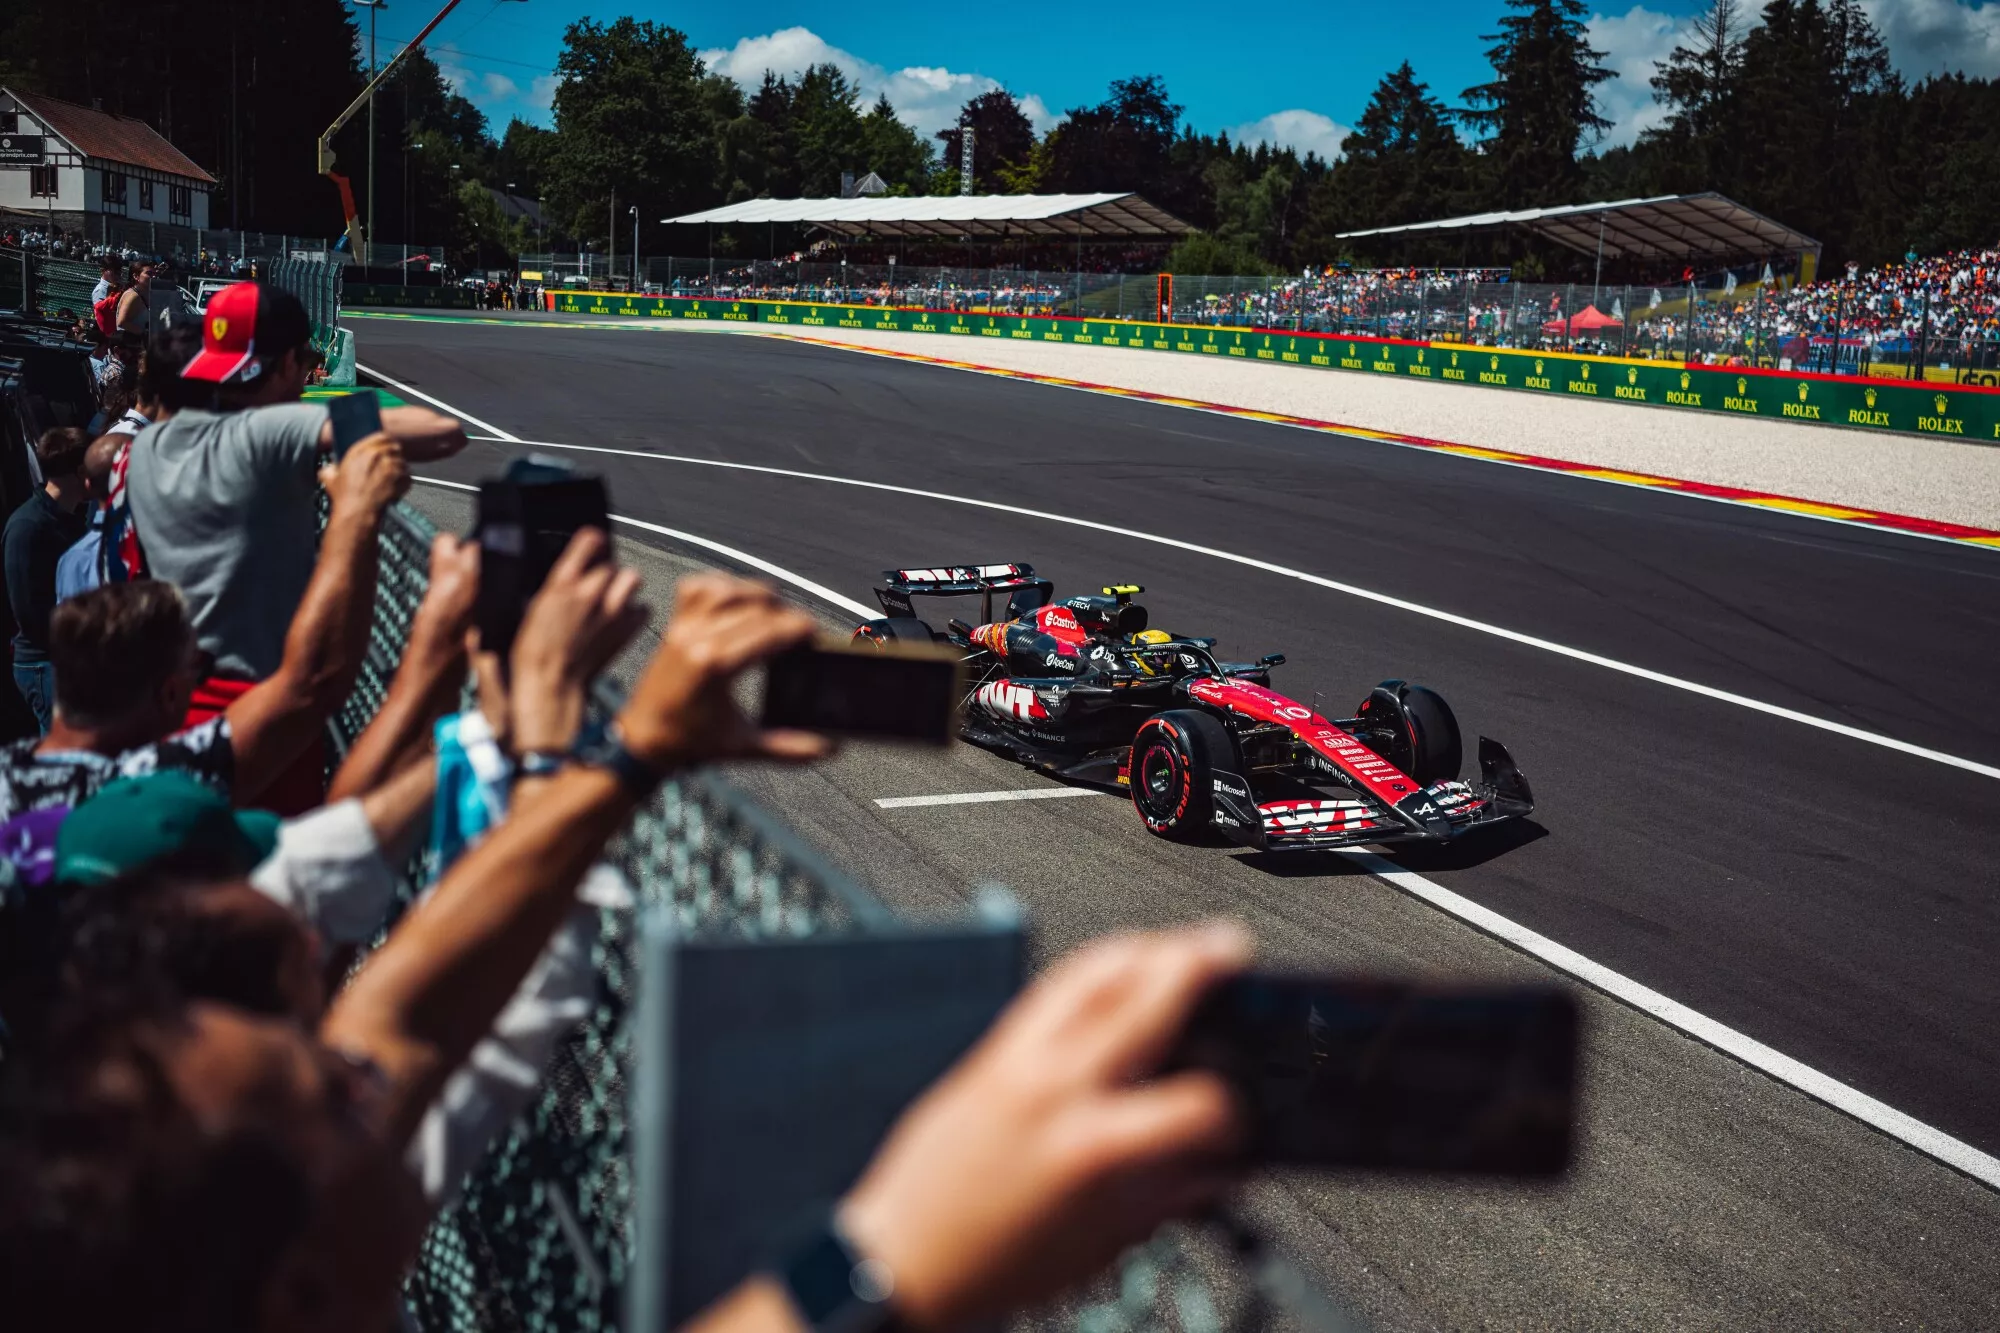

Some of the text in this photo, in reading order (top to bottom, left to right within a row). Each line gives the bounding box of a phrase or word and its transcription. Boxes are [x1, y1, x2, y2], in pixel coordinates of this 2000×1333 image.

[590, 306, 608, 314] ROLEX
[620, 308, 639, 316] ROLEX
[651, 309, 672, 317] ROLEX
[723, 312, 748, 321] ROLEX
[802, 317, 824, 325] ROLEX
[839, 320, 862, 328] ROLEX
[876, 322, 898, 330] ROLEX
[912, 324, 936, 332] ROLEX
[950, 326, 970, 334] ROLEX
[1012, 330, 1032, 338] ROLEX
[1044, 332, 1062, 341] ROLEX
[1074, 334, 1092, 342] ROLEX
[1102, 337, 1119, 345] ROLEX
[1177, 342, 1194, 351] ROLEX
[1202, 344, 1219, 353] ROLEX
[1229, 346, 1246, 356] ROLEX
[1257, 349, 1274, 358] ROLEX
[1282, 352, 1299, 362] ROLEX
[1311, 355, 1330, 365] ROLEX
[1341, 358, 1362, 368] ROLEX
[1374, 361, 1396, 372] ROLEX
[1409, 365, 1431, 376] ROLEX
[1442, 369, 1464, 380] ROLEX
[1479, 372, 1507, 384] ROLEX
[1525, 376, 1551, 389] ROLEX
[1568, 381, 1597, 394] ROLEX
[1615, 386, 1646, 400] ROLEX
[1667, 391, 1702, 405] ROLEX
[1724, 397, 1758, 412] ROLEX
[1782, 403, 1820, 419] ROLEX
[1848, 409, 1889, 426] ROLEX
[1918, 417, 1963, 434] ROLEX
[1052, 615, 1078, 630] Castrol
[1103, 649, 1116, 663] bp
[1053, 657, 1075, 671] ApeCoin
[1273, 706, 1312, 720] 10
[1037, 731, 1066, 743] BINANCE
[1318, 758, 1353, 785] INFINOX
[1221, 783, 1246, 798] Microsoft
